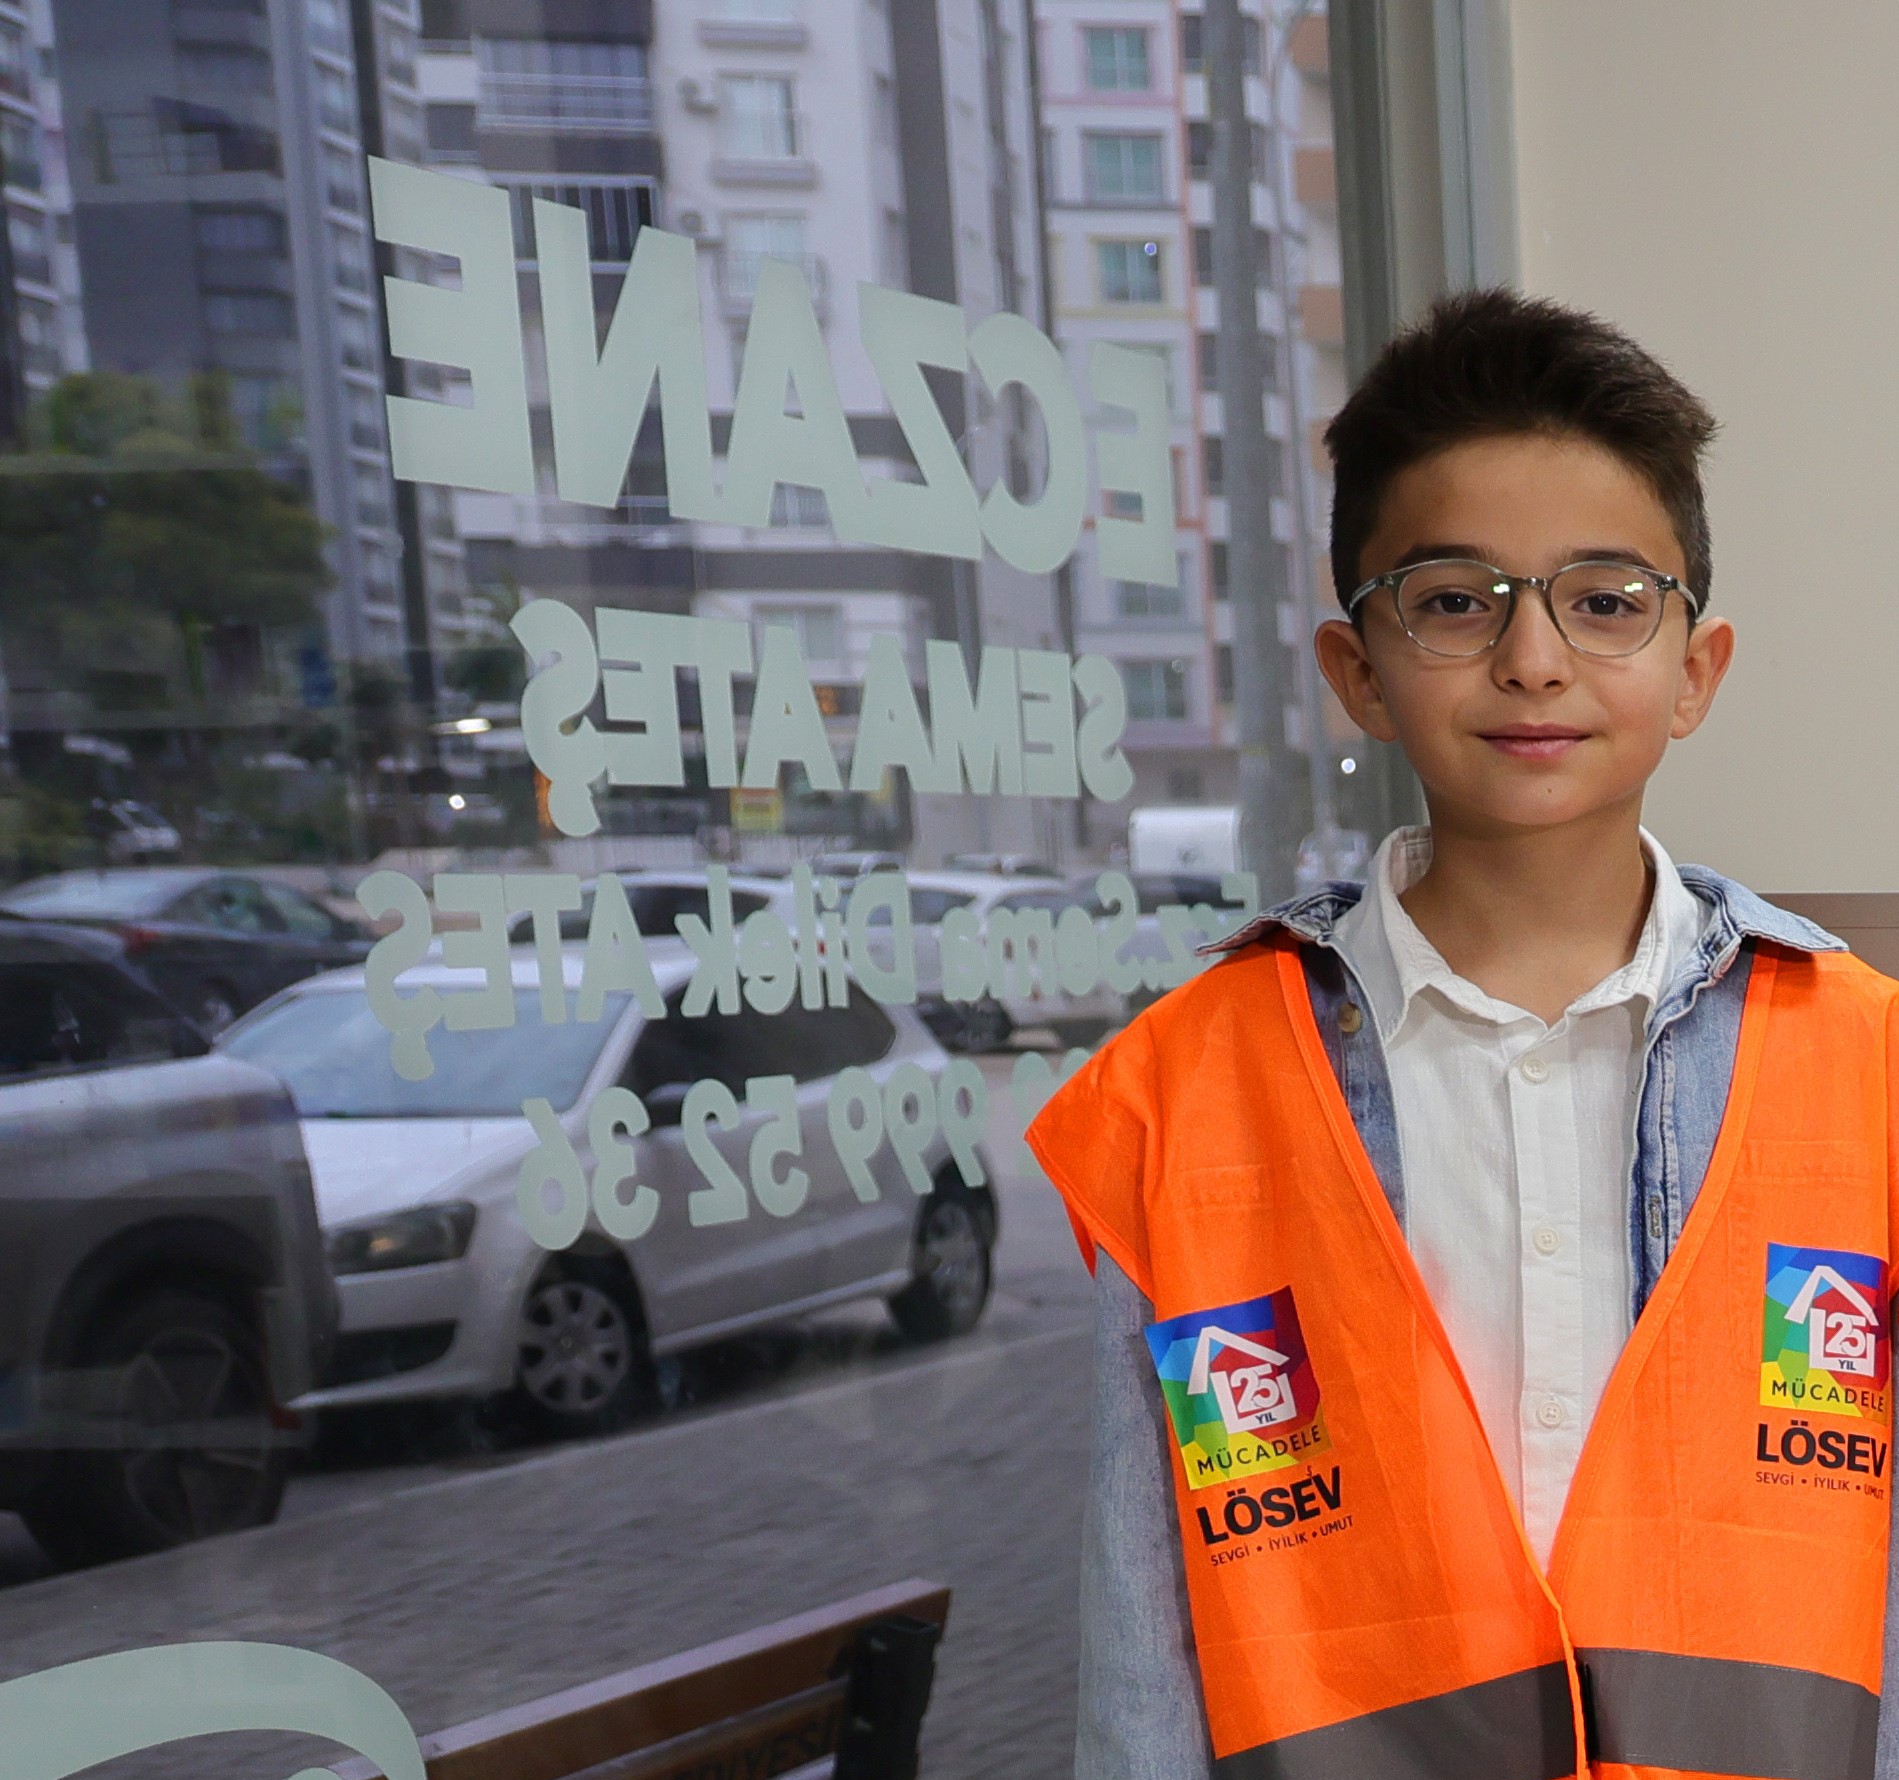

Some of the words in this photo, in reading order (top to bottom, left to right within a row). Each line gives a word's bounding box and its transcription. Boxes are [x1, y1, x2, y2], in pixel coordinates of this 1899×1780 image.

[1826, 1312, 1866, 1356] 25
[1231, 1363, 1281, 1413] 25
[1838, 1359, 1856, 1371] YIL
[1255, 1412, 1276, 1424] YIL
[1772, 1378, 1884, 1413] MÜCADELE
[1197, 1425, 1321, 1475] MÜCADELE
[1757, 1420, 1887, 1478] LÖSEV
[1196, 1466, 1341, 1545] LÖSEV
[1211, 1542, 1250, 1566] SEVGİ
[1320, 1515, 1353, 1537] UMUT
